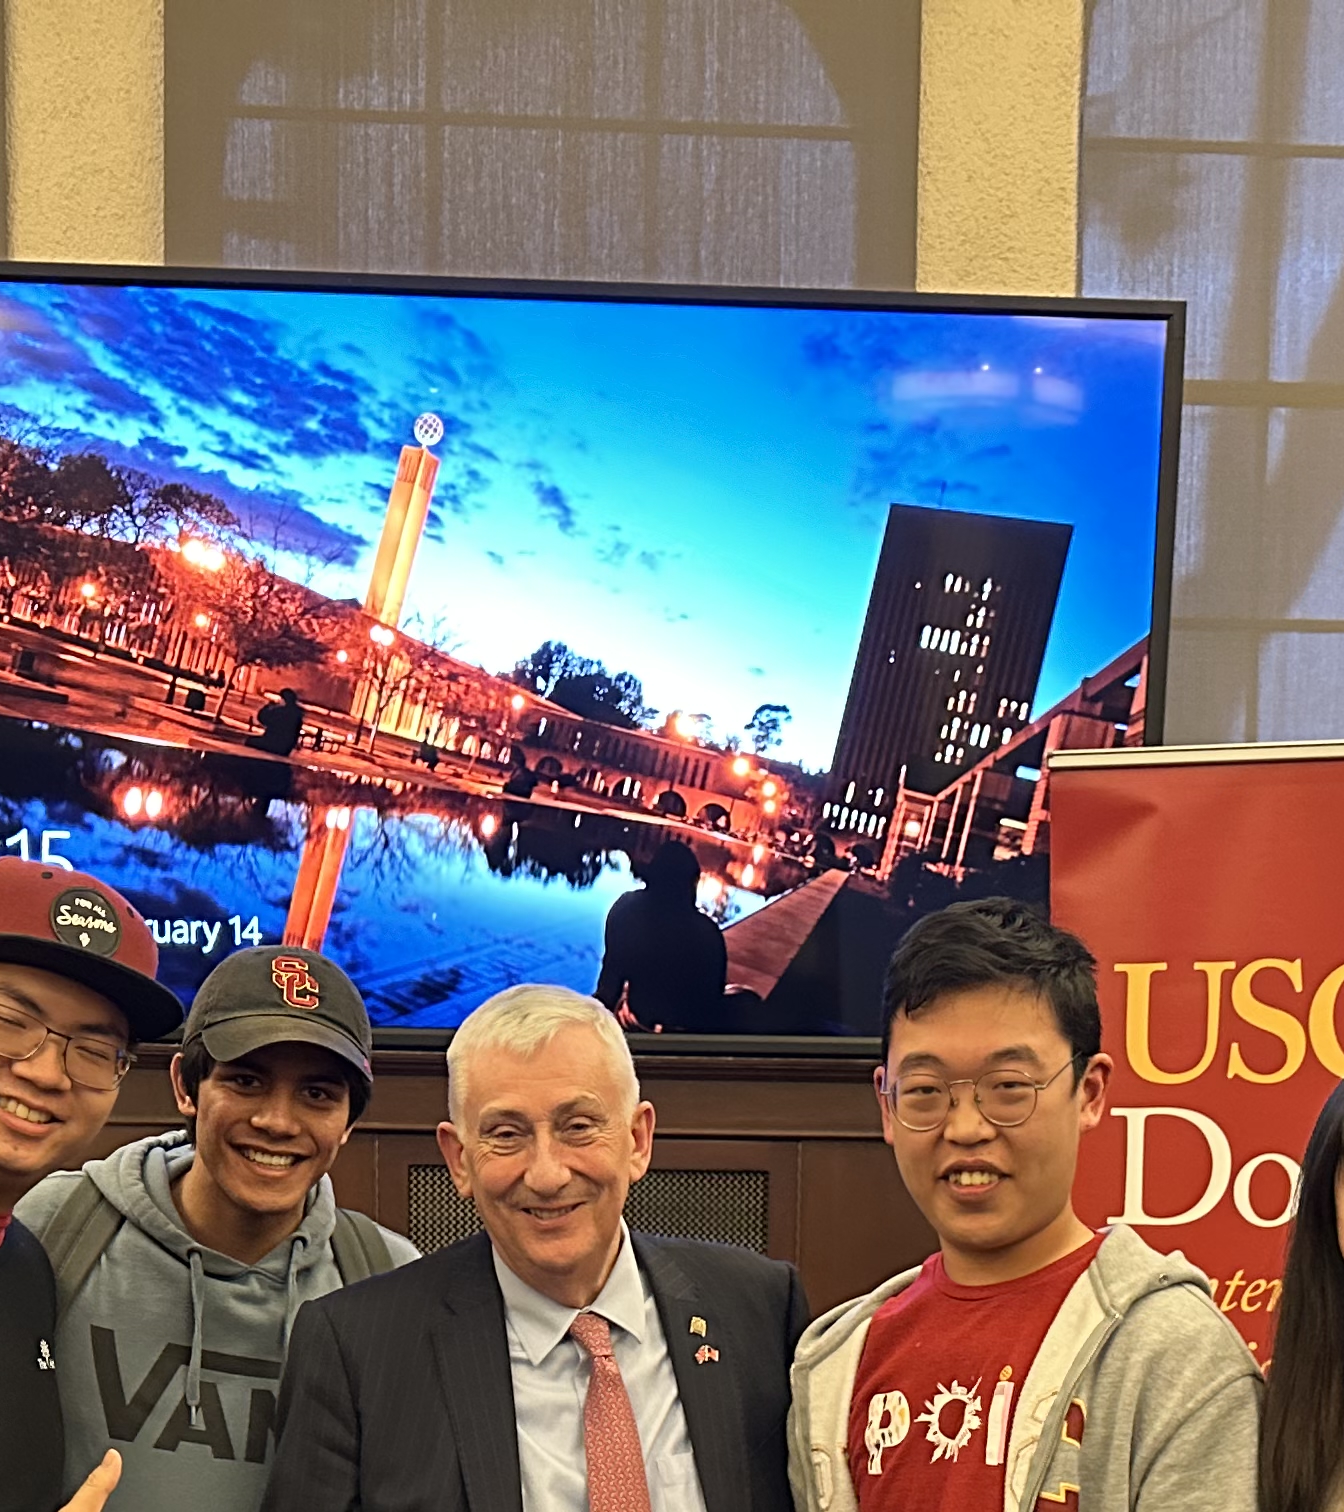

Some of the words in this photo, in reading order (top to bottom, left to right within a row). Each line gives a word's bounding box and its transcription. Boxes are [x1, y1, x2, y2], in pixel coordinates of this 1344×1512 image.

[144, 919, 221, 954] uary
[228, 914, 263, 946] 14
[90, 1323, 282, 1464] VAN
